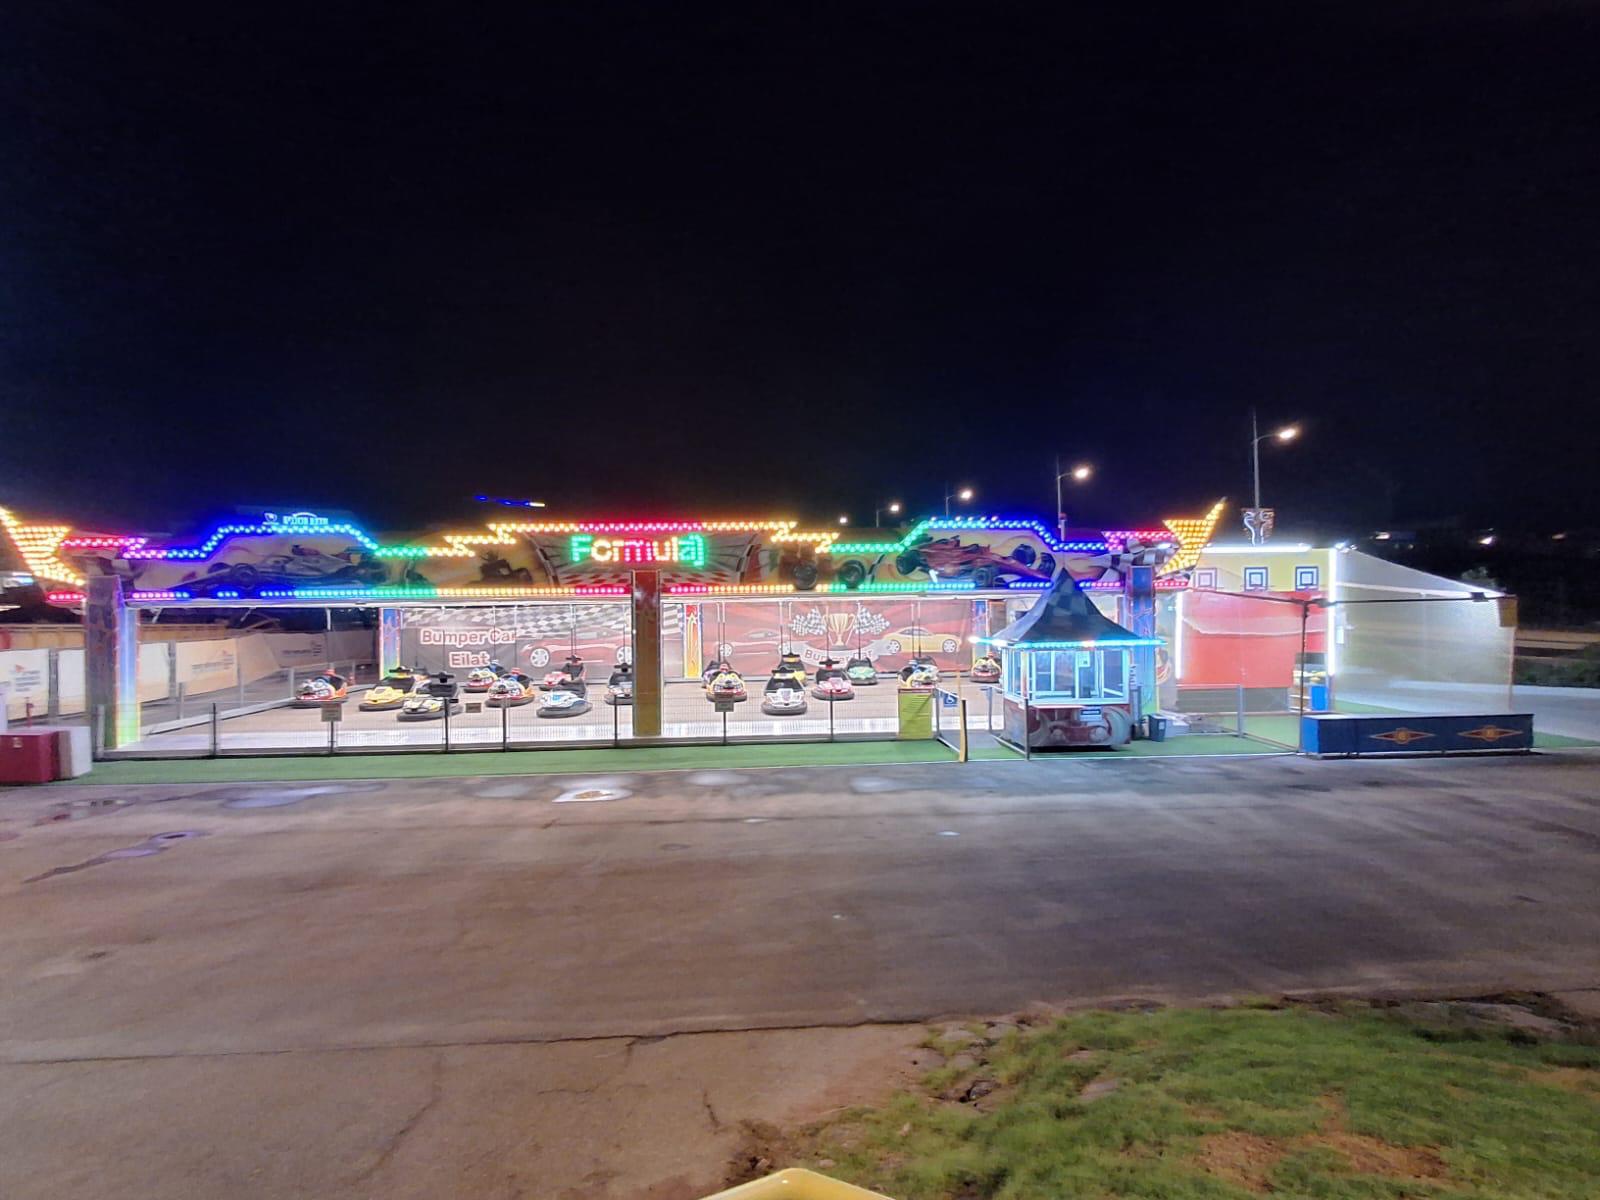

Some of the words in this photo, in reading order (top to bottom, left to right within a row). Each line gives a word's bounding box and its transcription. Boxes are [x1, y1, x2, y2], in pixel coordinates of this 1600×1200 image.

[421, 628, 487, 648] Bumper
[488, 627, 516, 644] Car
[450, 652, 489, 667] Eilat
